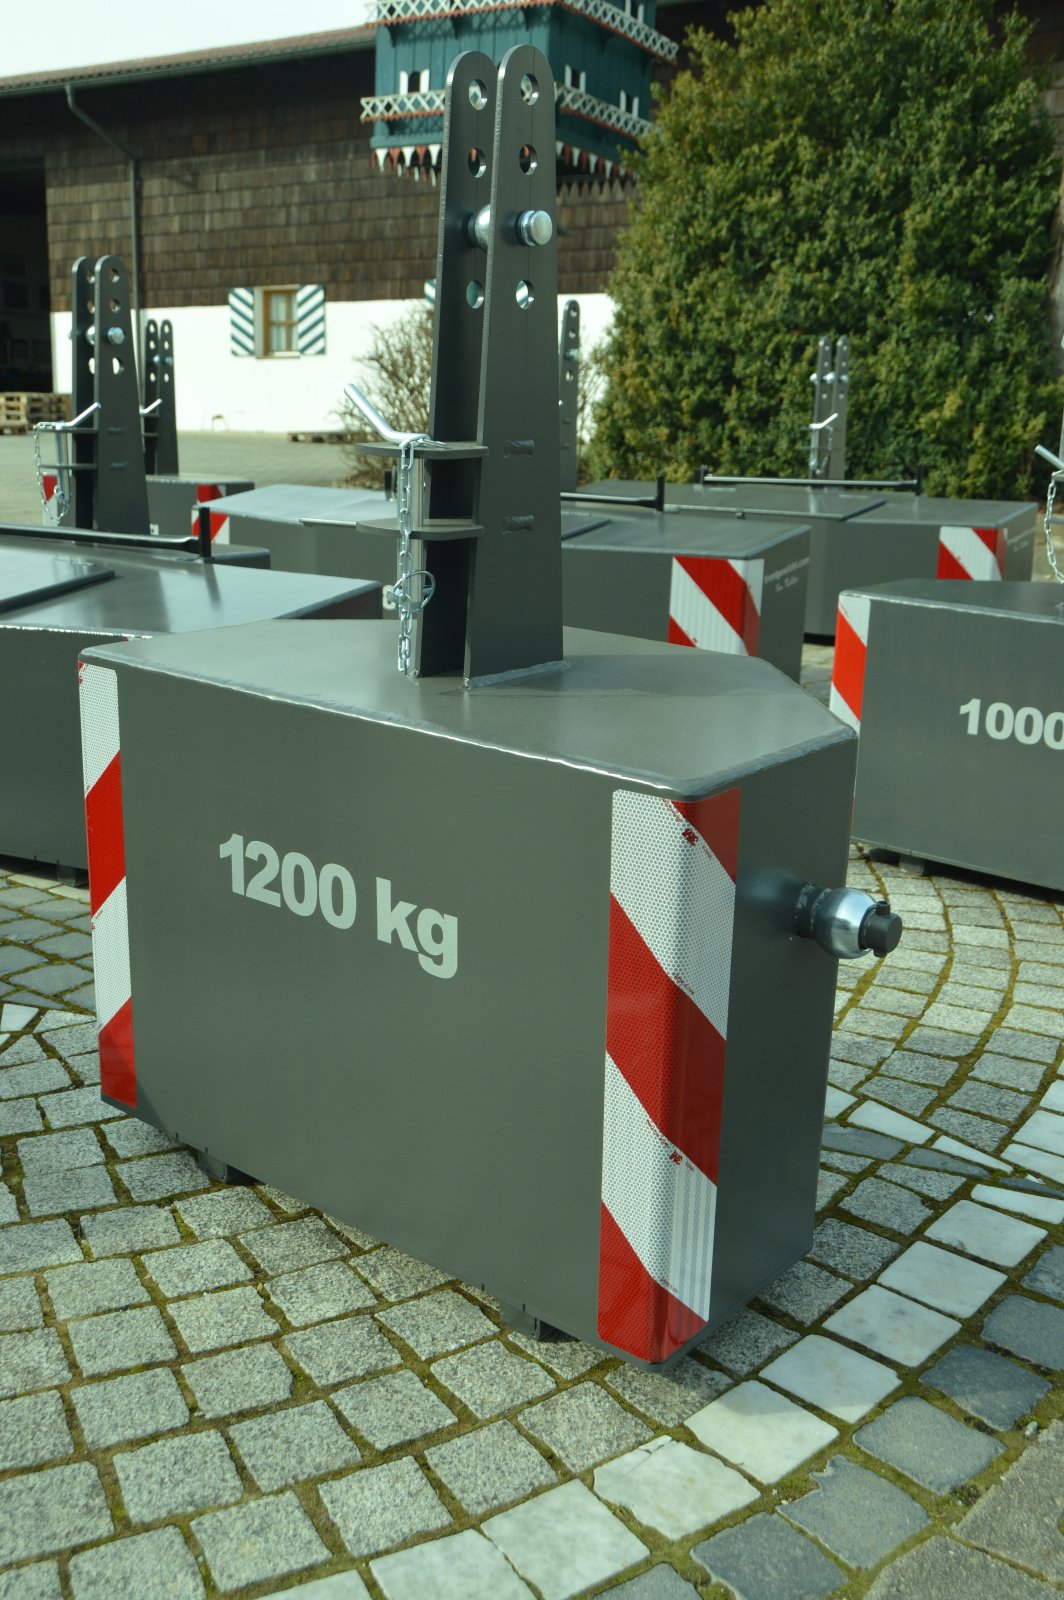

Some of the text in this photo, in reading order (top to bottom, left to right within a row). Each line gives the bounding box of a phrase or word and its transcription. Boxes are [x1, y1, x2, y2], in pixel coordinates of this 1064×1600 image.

[959, 698, 1064, 750] 1000
[219, 833, 458, 979] 1200 kg
